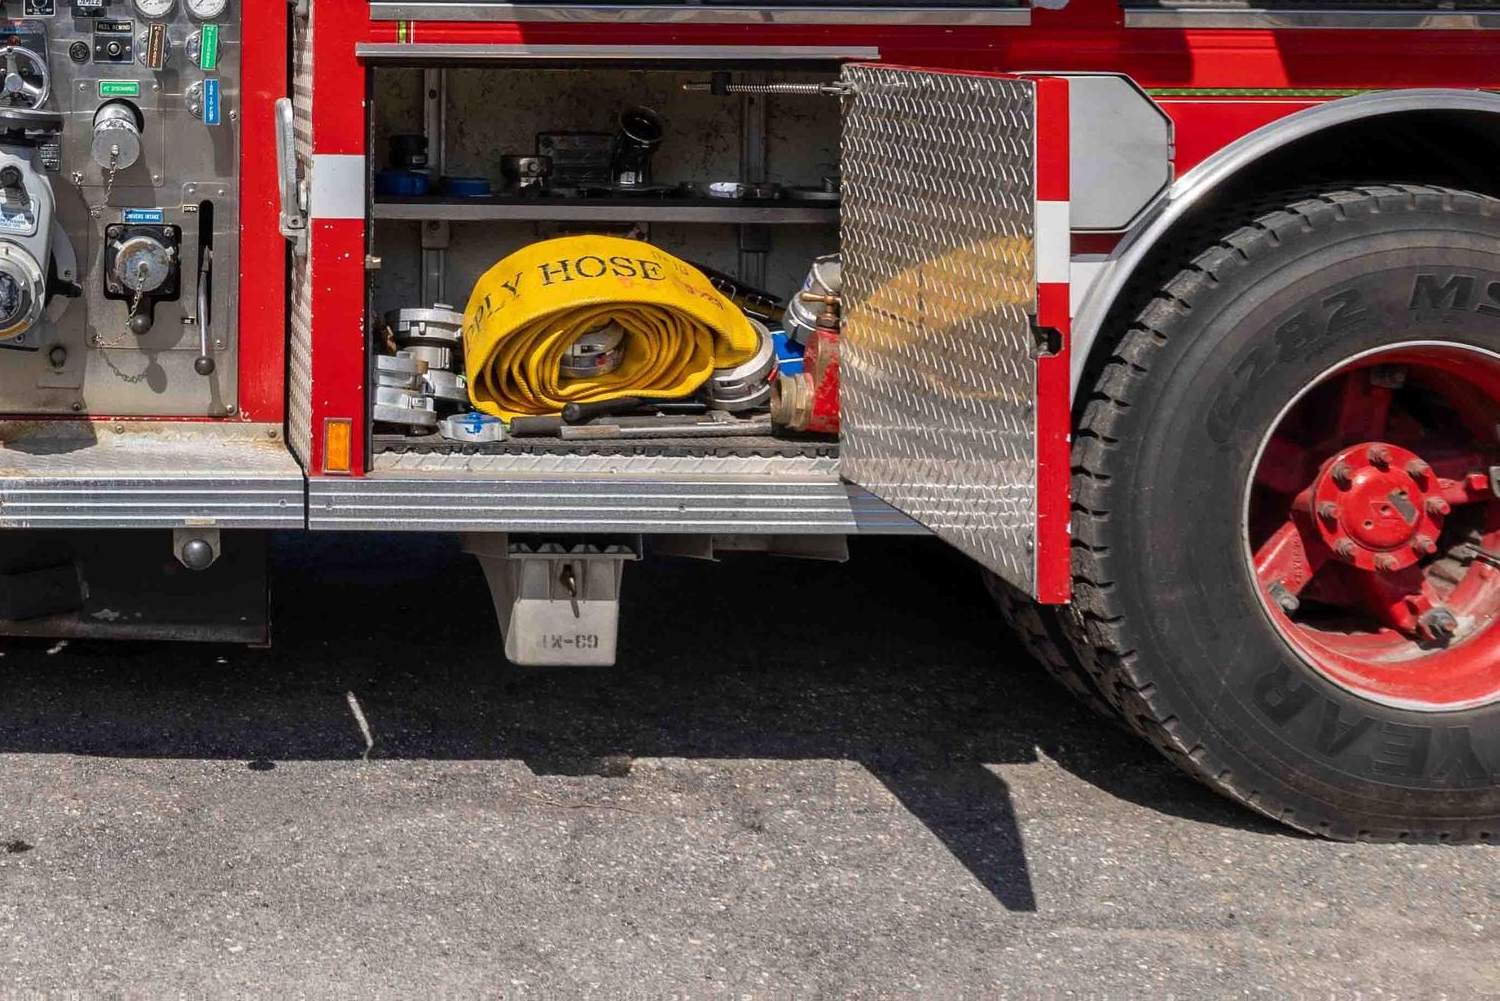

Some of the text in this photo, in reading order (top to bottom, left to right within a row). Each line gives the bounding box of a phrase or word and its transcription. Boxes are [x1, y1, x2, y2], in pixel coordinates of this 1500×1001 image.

[540, 256, 665, 286] HOSE
[1207, 288, 1368, 444] G282
[1254, 662, 1490, 782] YEAR
